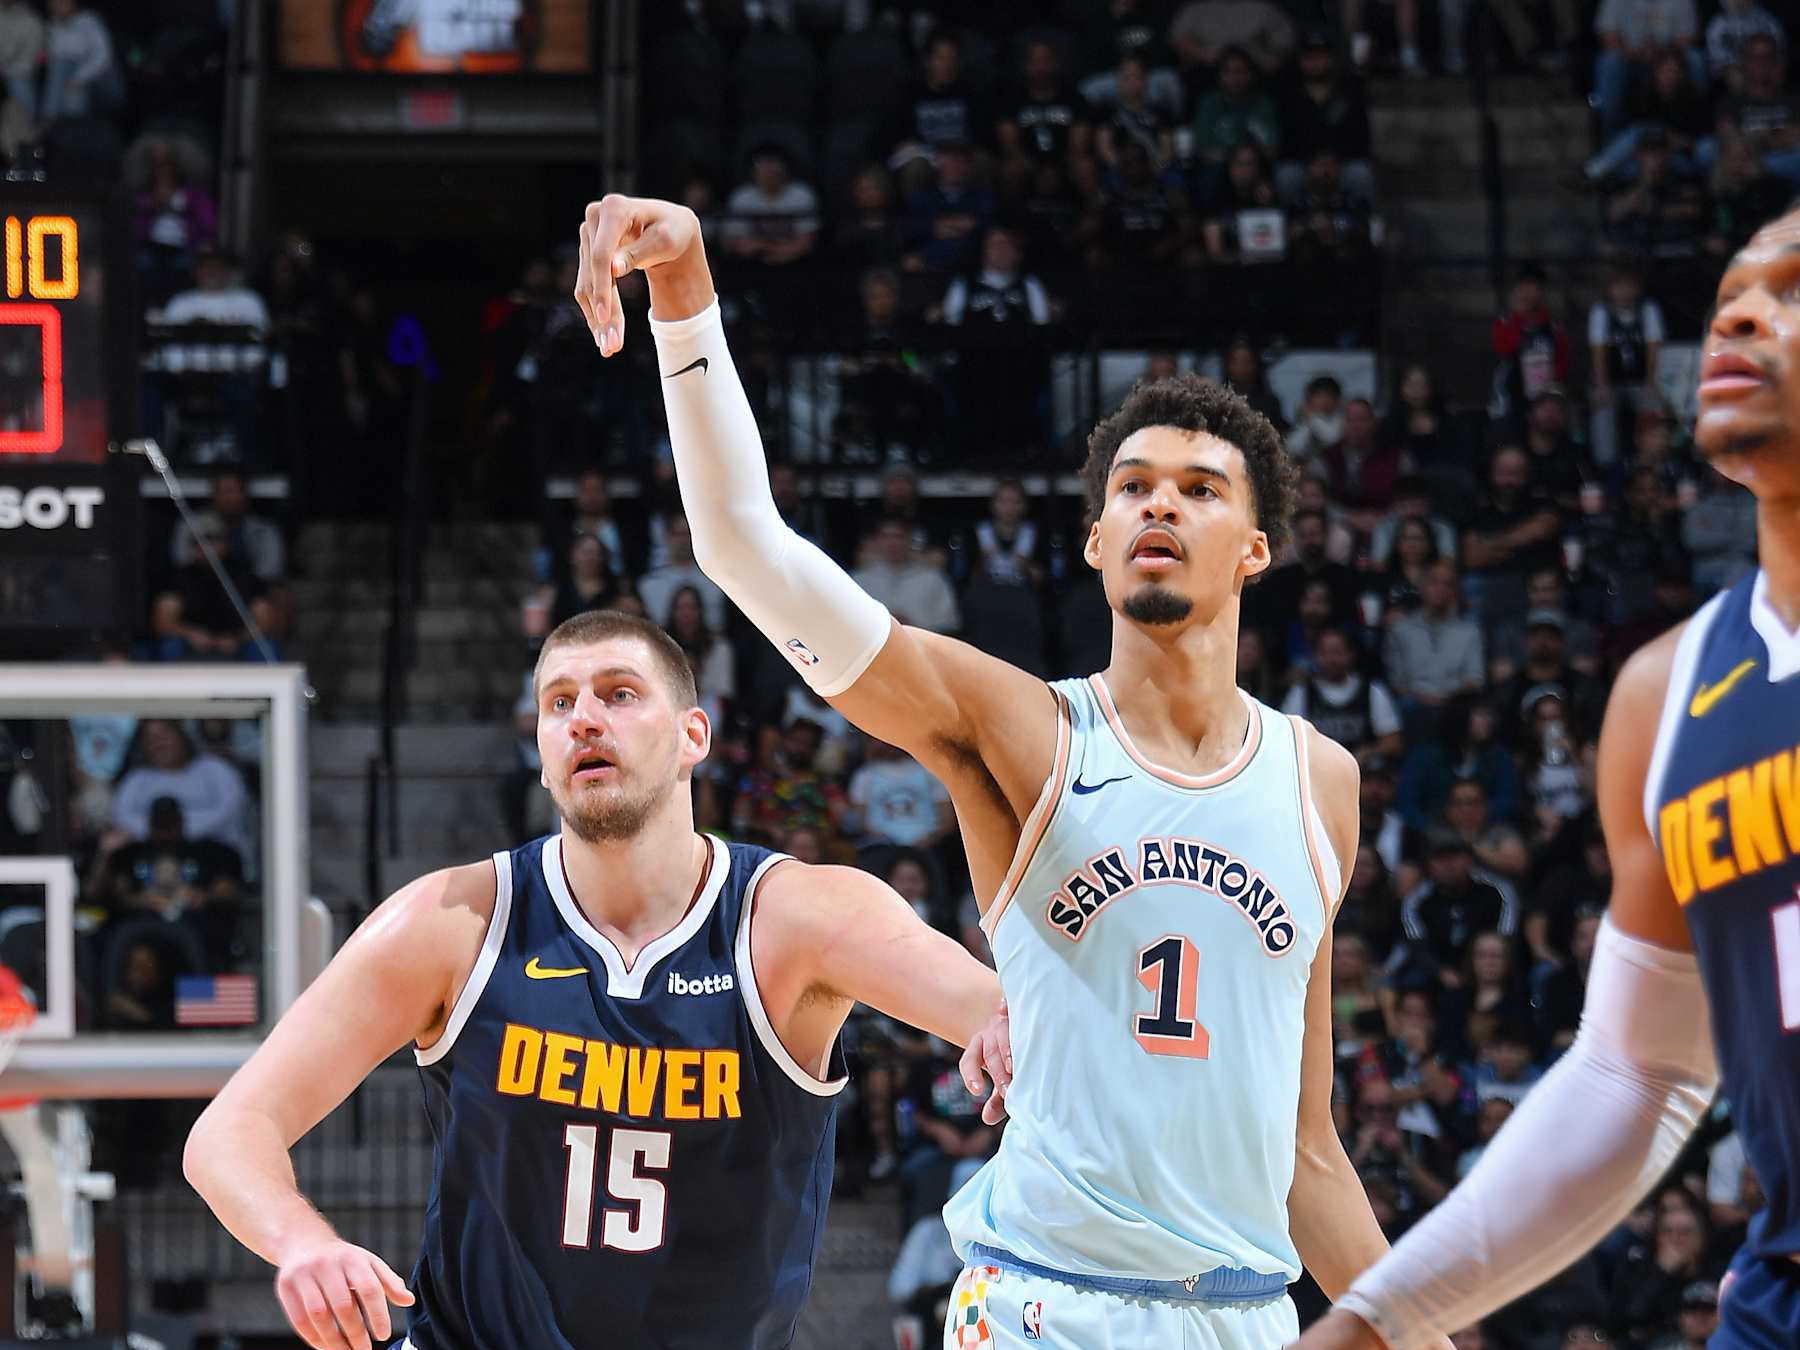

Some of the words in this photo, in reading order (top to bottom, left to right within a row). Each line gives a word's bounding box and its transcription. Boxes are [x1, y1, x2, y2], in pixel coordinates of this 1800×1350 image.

[6, 216, 79, 299] 10
[1046, 847, 1139, 944] SAN
[1137, 836, 1298, 958] ANTONIO
[667, 972, 735, 997] ibotta
[1132, 934, 1210, 1060] 1
[496, 1022, 742, 1121] DENVER
[560, 1122, 673, 1255] 15
